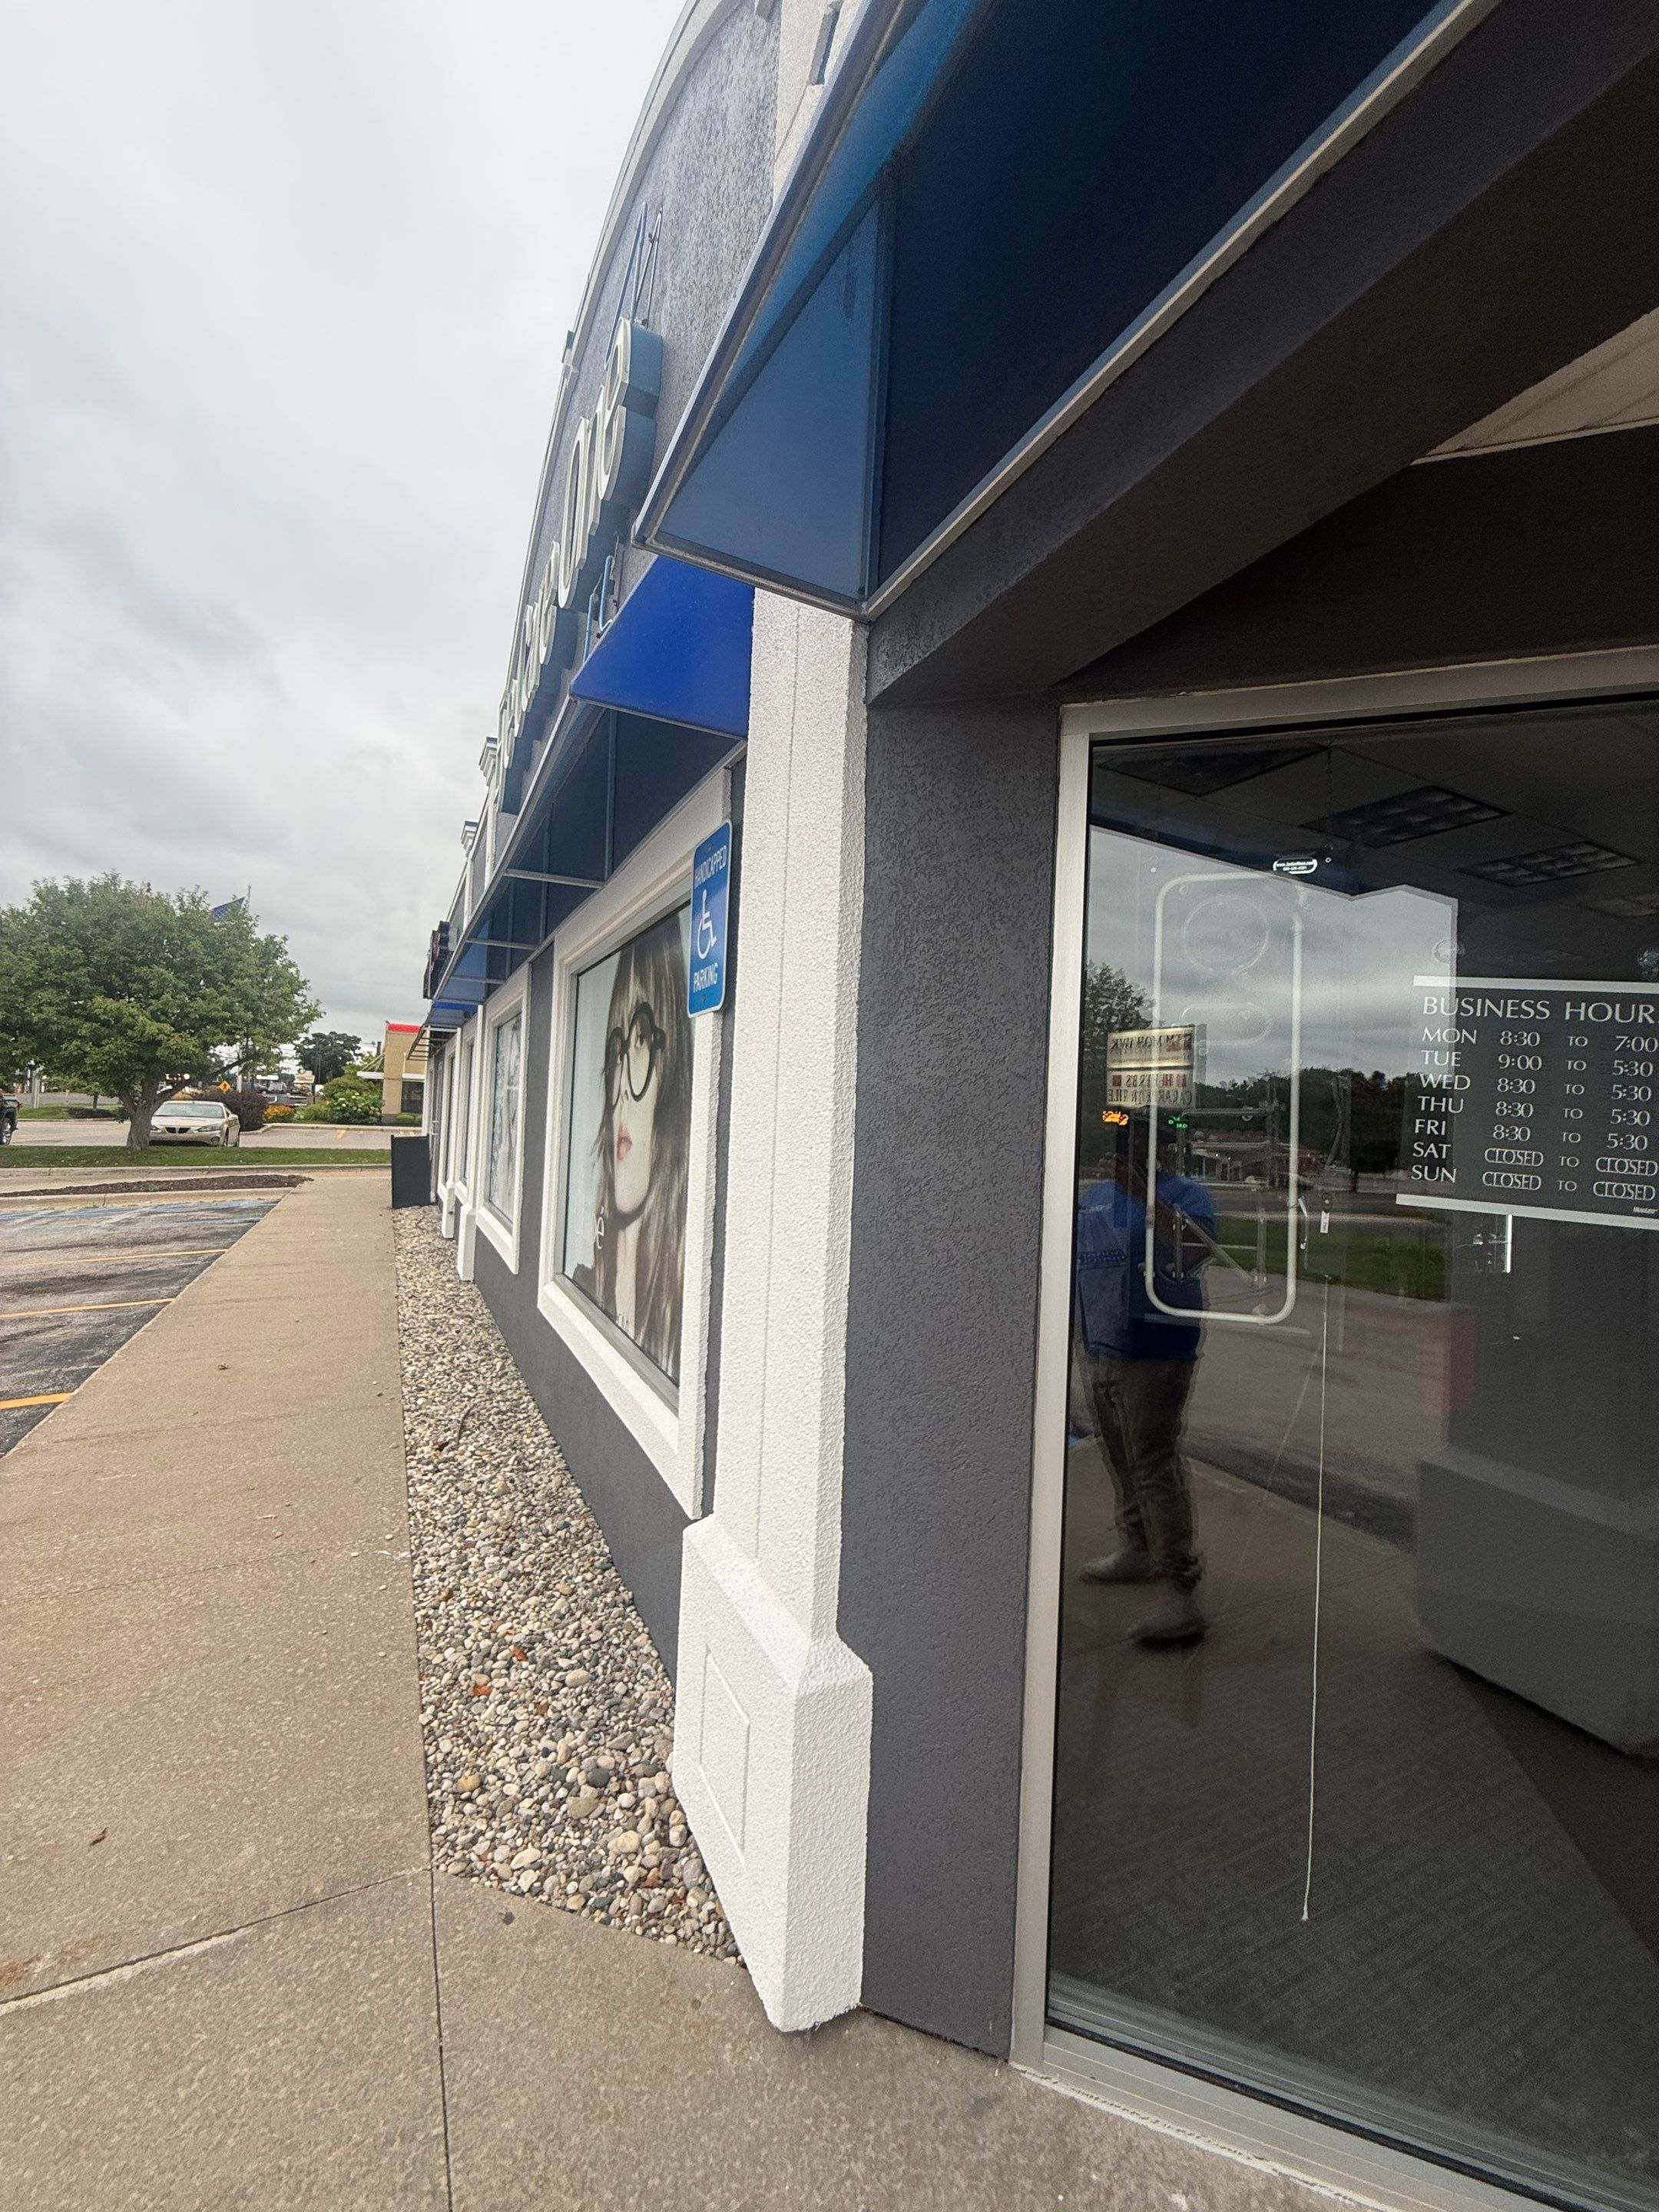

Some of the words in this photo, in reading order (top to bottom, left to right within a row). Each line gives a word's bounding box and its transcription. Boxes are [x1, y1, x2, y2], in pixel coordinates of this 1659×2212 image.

[694, 845, 727, 889] HANDICAPPED
[694, 962, 718, 992] PARKING
[1422, 996, 1551, 1020] BUSINESS
[1565, 1001, 1659, 1025] HOUR
[1422, 1027, 1477, 1045] MON
[1499, 1030, 1541, 1048] 8:30
[1567, 1035, 1588, 1048] TO
[1614, 1035, 1659, 1053] 7:00
[1421, 1049, 1462, 1068] TUE
[1498, 1053, 1543, 1071] 9:00
[1566, 1059, 1588, 1071] TO
[1611, 1059, 1654, 1078] 5:30
[1419, 1072, 1472, 1091] WED
[1496, 1077, 1536, 1095] 8:30
[1564, 1083, 1585, 1095] TO
[1610, 1084, 1652, 1102] 5:30
[1416, 1095, 1465, 1114] THU
[1495, 1101, 1535, 1118] 8:30
[1562, 1107, 1584, 1119] TO
[1609, 1108, 1651, 1127] 5:30
[1414, 1118, 1447, 1136] FRI
[1492, 1124, 1532, 1142] 8:30
[1561, 1131, 1582, 1144] TO
[1605, 1132, 1648, 1151] 5:30
[1412, 1141, 1452, 1160] SAT
[1484, 1147, 1545, 1167] CLOSED
[1558, 1155, 1580, 1167] TO
[1594, 1156, 1659, 1177] CLOSED
[1410, 1164, 1458, 1184] SUN
[1482, 1171, 1542, 1191] CLOSED
[1556, 1180, 1578, 1192] TO
[1592, 1181, 1656, 1201] CLOSED
